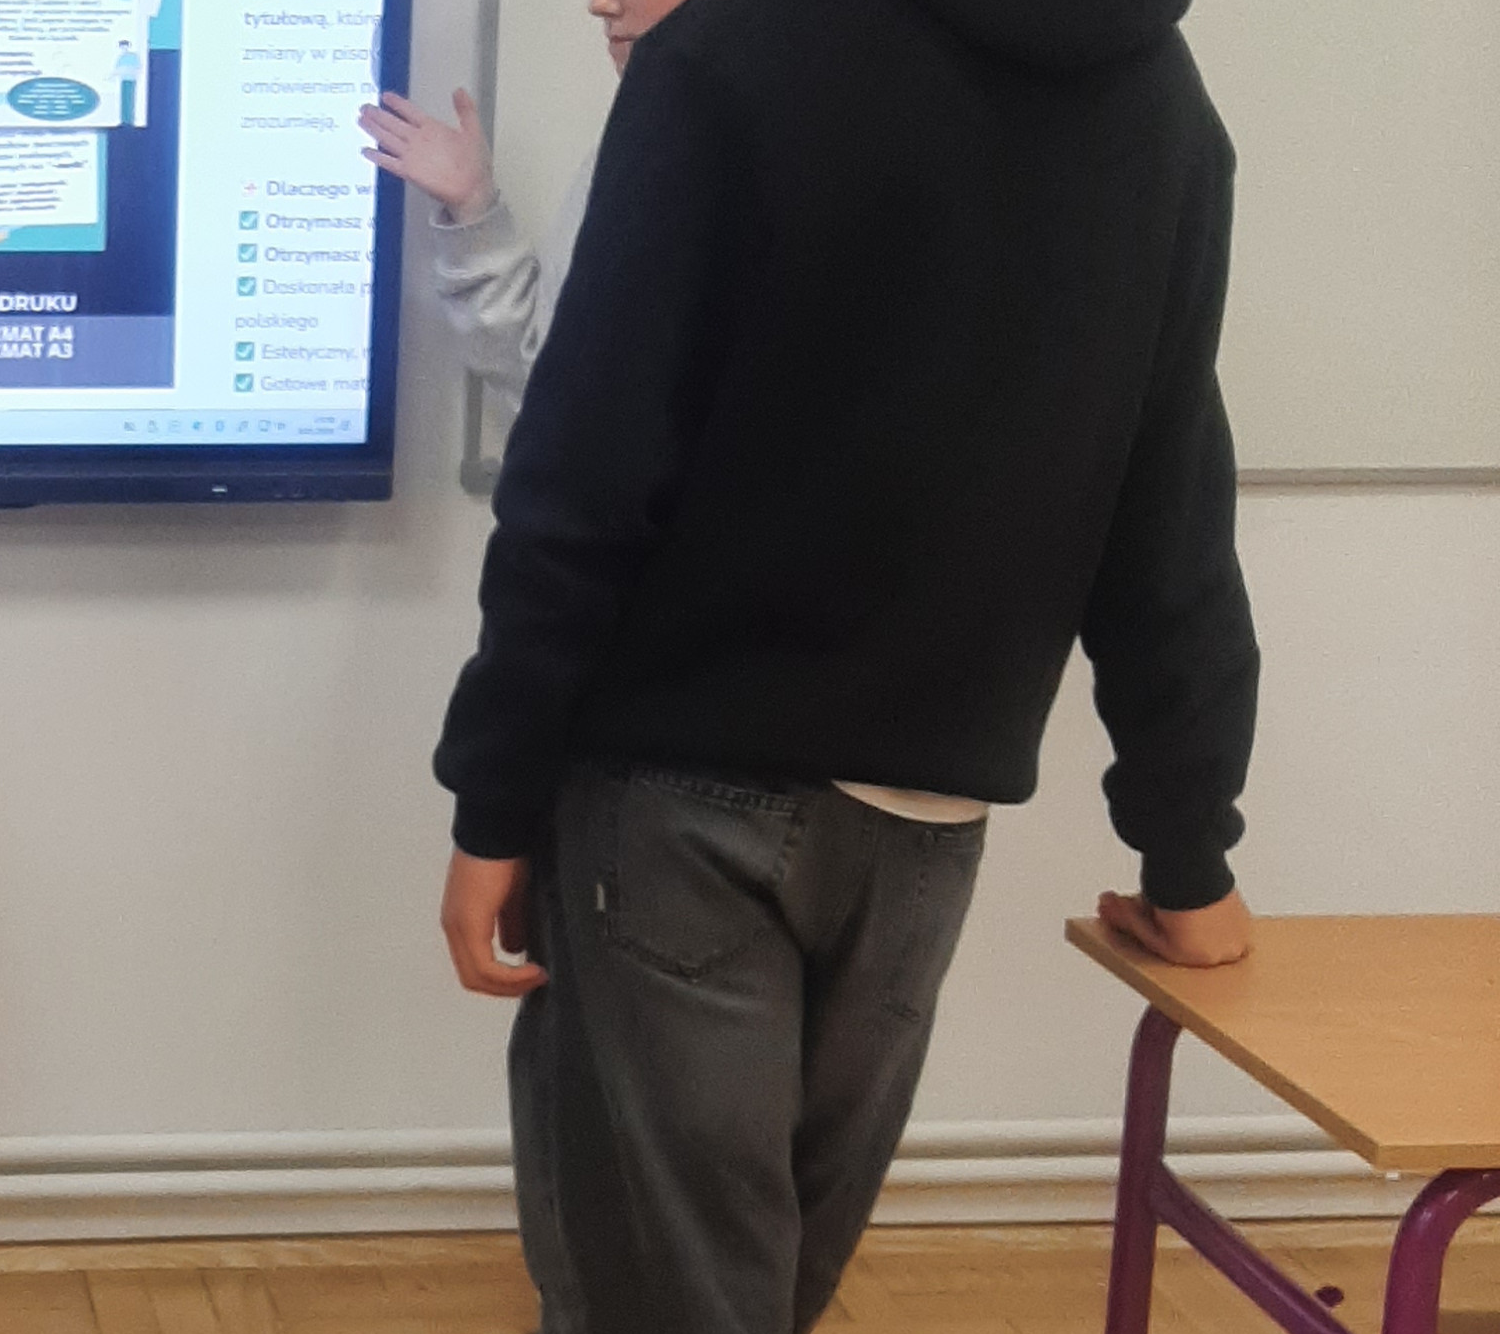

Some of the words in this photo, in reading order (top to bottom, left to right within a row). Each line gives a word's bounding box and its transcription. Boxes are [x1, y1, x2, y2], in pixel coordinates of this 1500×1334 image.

[310, 49, 328, 60] w
[266, 180, 350, 200] Dlaczego
[265, 213, 362, 231] Otrzymasz
[264, 247, 361, 265] Otrzymasz
[235, 312, 318, 332] polskiego
[48, 326, 74, 342] A4
[48, 342, 74, 359] A3
